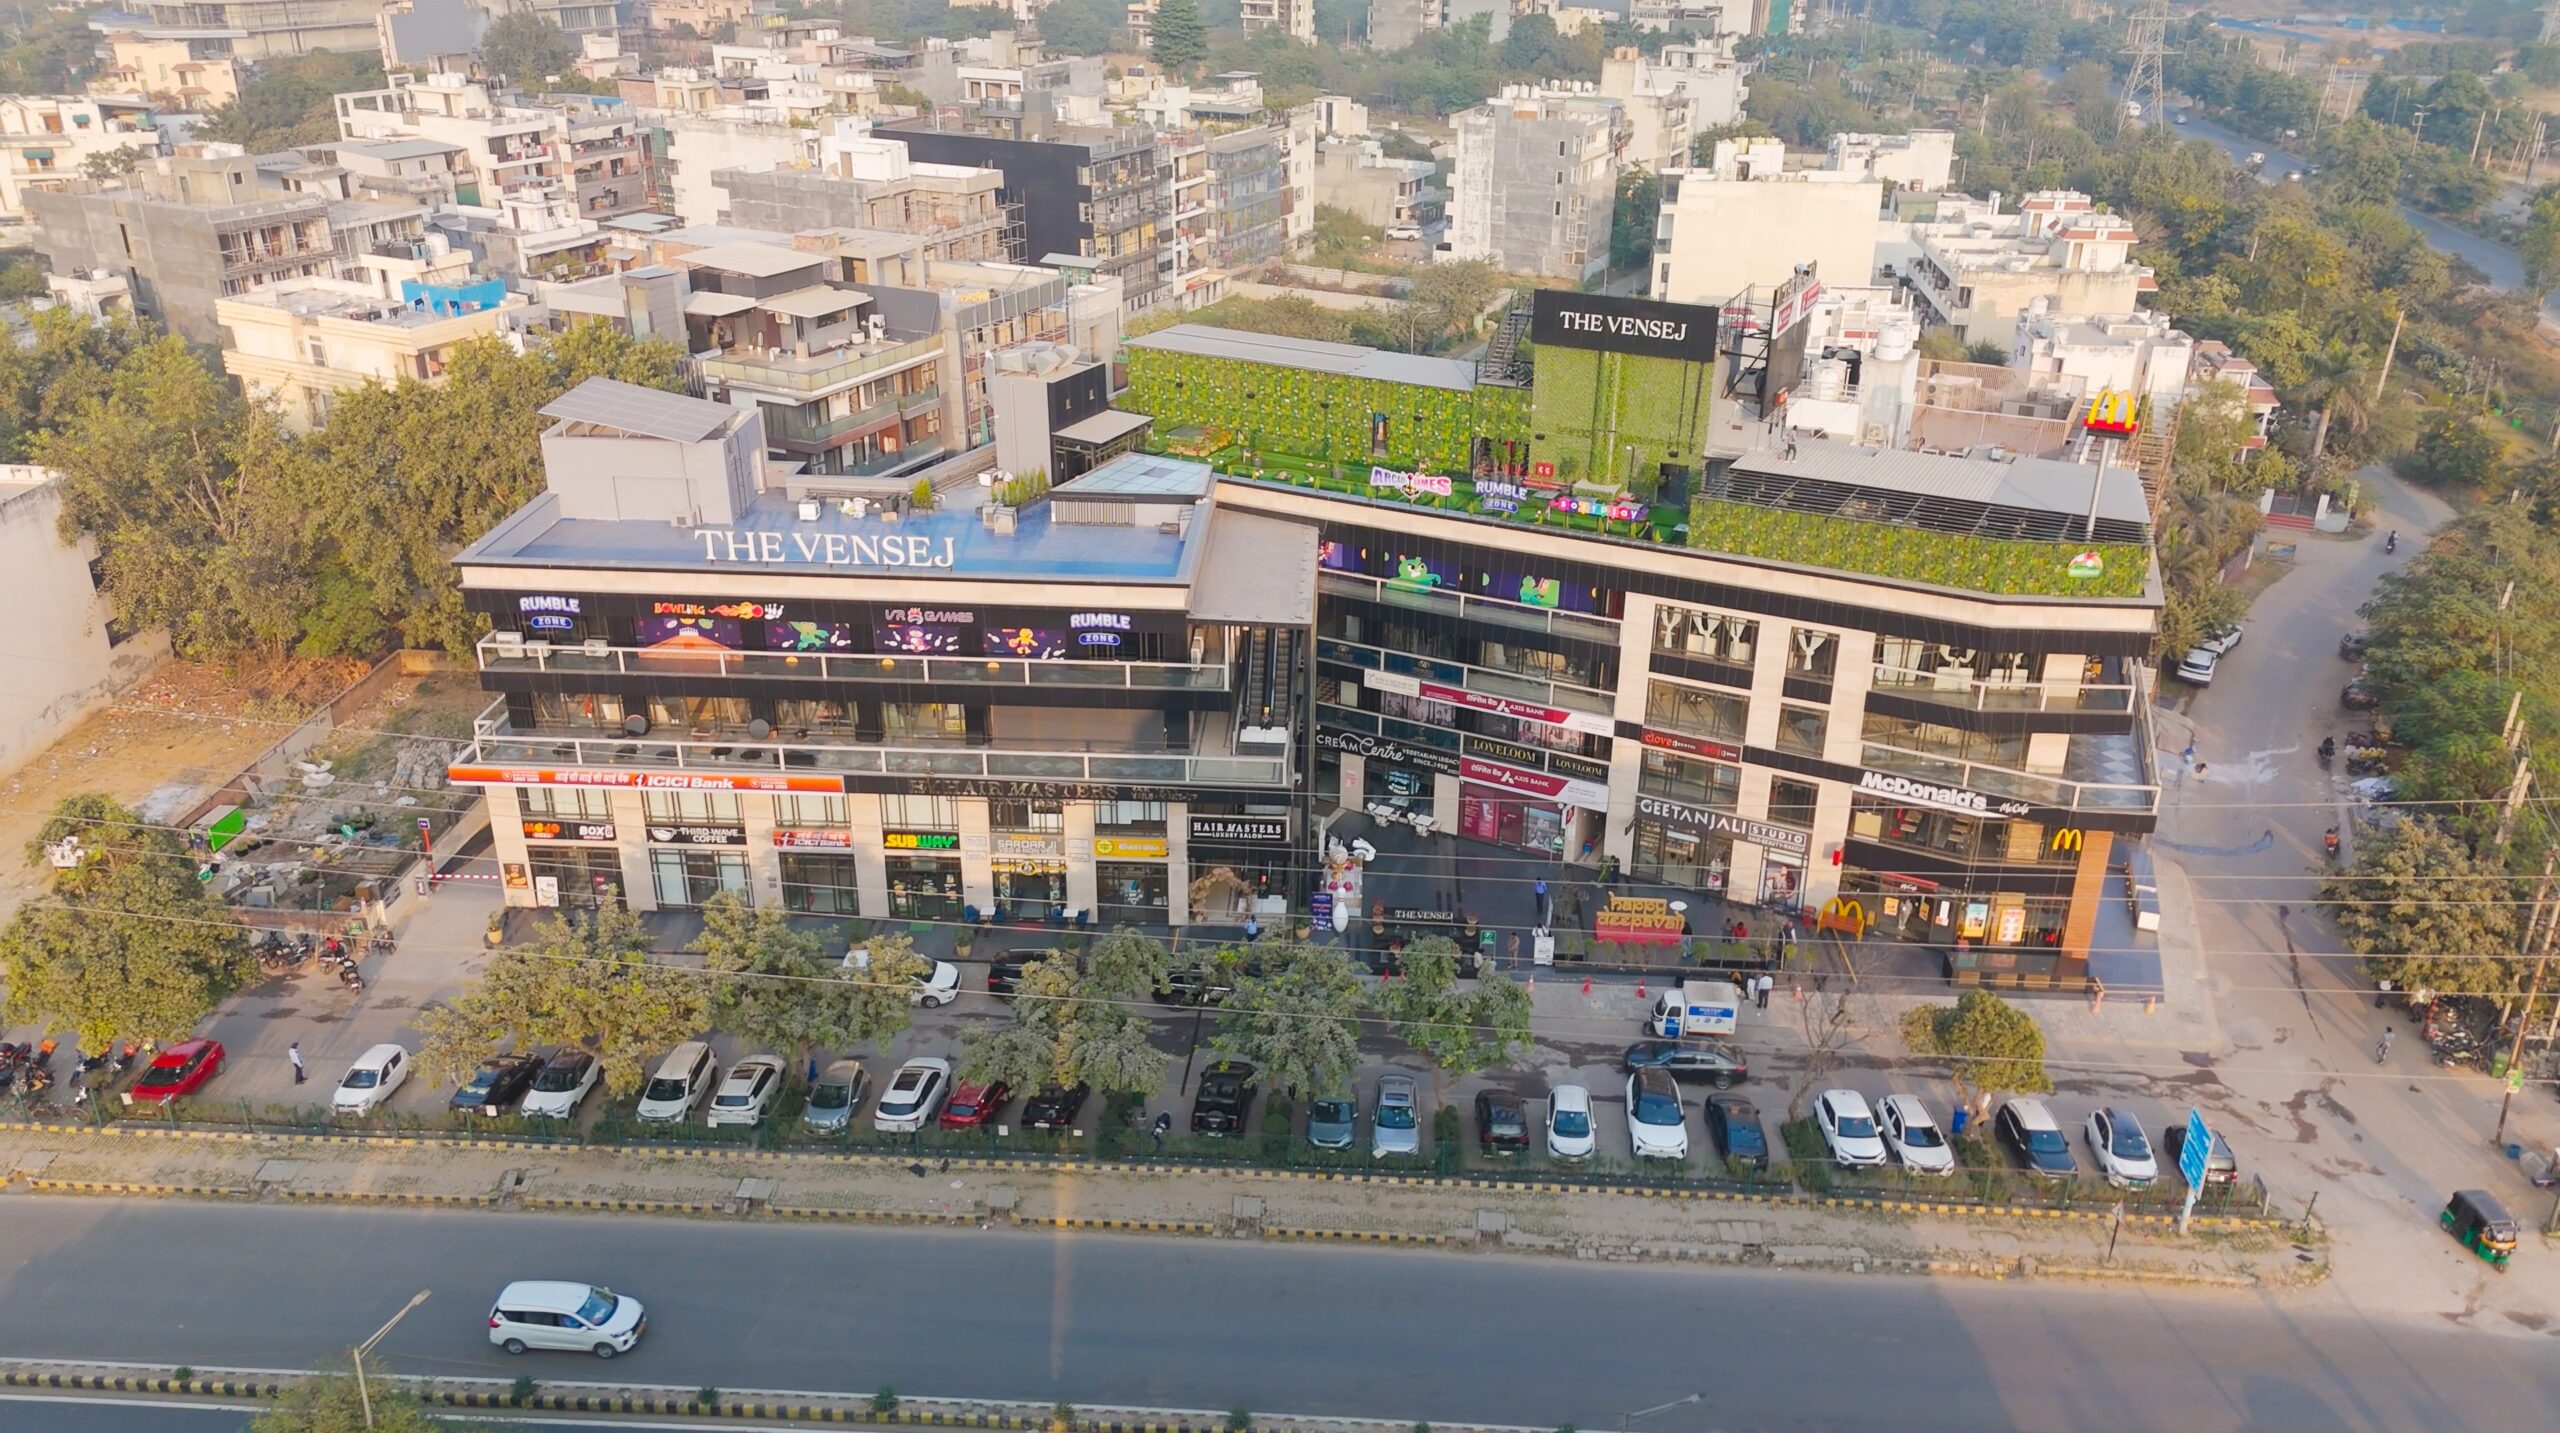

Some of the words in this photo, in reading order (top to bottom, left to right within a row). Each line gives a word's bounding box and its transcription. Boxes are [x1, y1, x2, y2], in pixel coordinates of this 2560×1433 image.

[1560, 311, 1603, 332] THE
[1607, 315, 1688, 341] VENSEJ
[1476, 481, 1528, 501] RUMBLE
[1489, 501, 1513, 510] ZONE
[694, 529, 785, 562] THE
[792, 532, 954, 567] VENSEJ
[519, 596, 580, 613] RUMBLE
[654, 602, 705, 616] BOWLING
[537, 617, 568, 628] ZONE
[924, 610, 974, 623] GAMES
[1070, 613, 1131, 630] RUMBLE
[1086, 634, 1115, 644] ZONE
[1316, 734, 1359, 752] CREAM
[1645, 732, 1672, 746] clove
[1474, 740, 1536, 762] LOVELOOM
[1556, 759, 1602, 776] LOVELOOM
[647, 775, 688, 787] ICICI
[690, 777, 734, 789] Bank
[1860, 771, 1987, 811] McDonald's
[1640, 799, 1746, 835] GEETANJALI
[680, 827, 708, 836] THIRD
[709, 828, 738, 837] WAVE
[1193, 822, 1224, 832] HAIR
[1226, 823, 1281, 834] MASTERS
[1752, 825, 1803, 844] STUDIO
[693, 835, 728, 844] COFFEE
[884, 833, 957, 849] SUBWAY
[997, 840, 1046, 849] SARDAR
[1395, 910, 1416, 919] THE
[1417, 911, 1454, 921] VENSEJ
